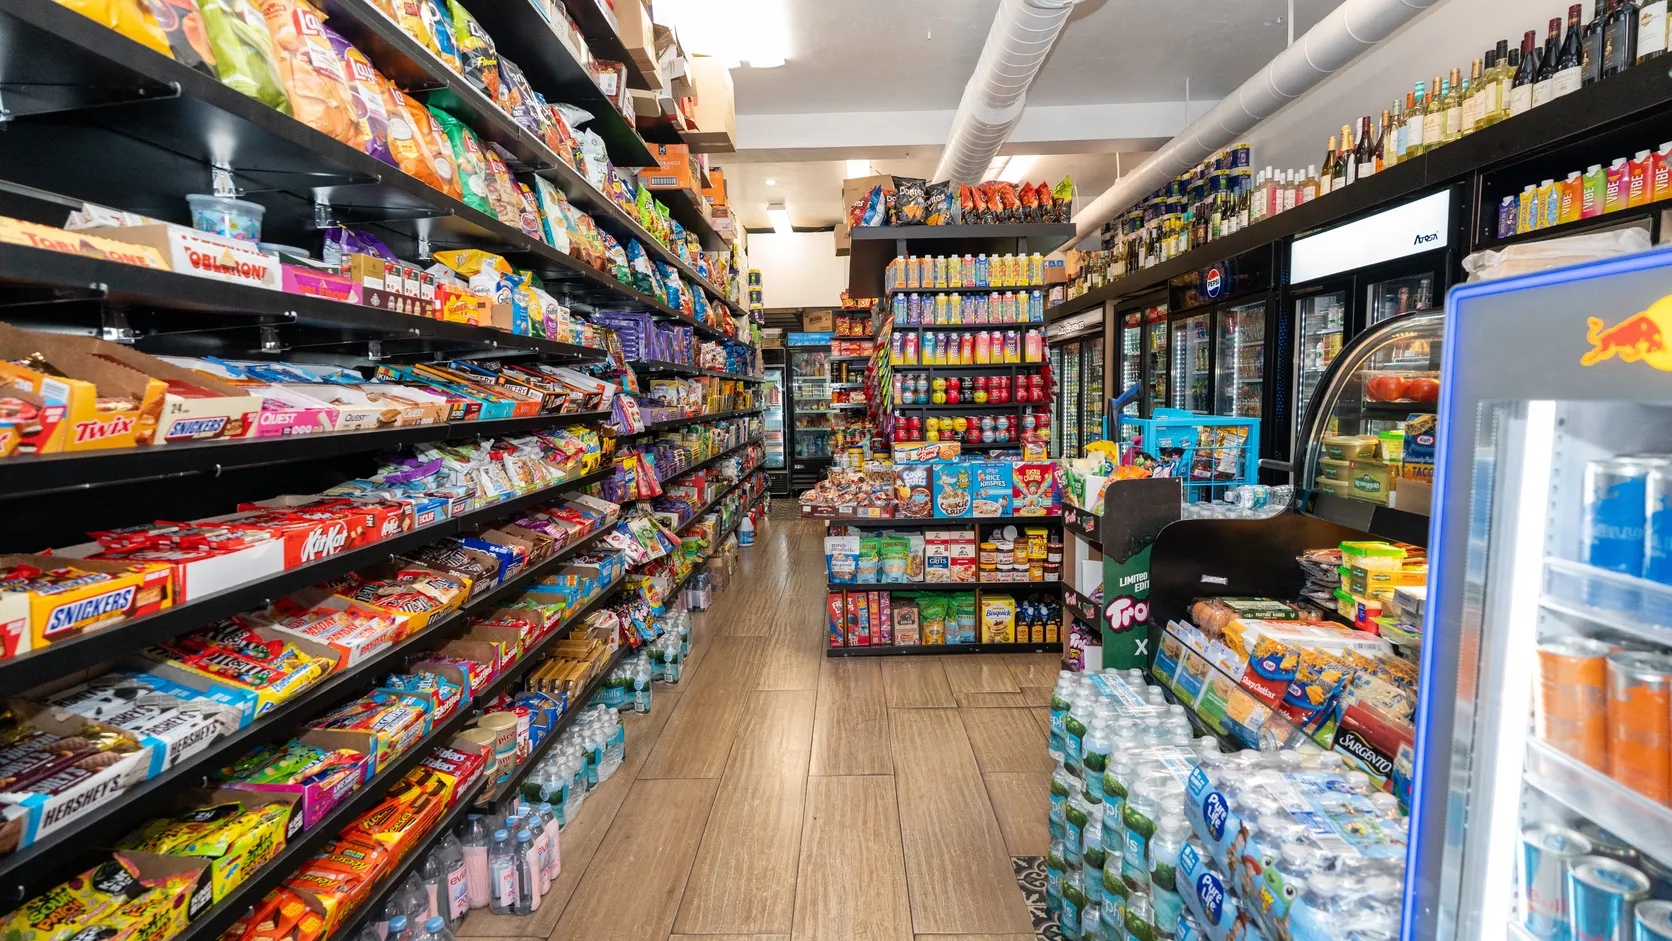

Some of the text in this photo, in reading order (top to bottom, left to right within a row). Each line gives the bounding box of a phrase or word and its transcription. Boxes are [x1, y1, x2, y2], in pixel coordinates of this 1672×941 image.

[899, 187, 925, 198] Doritos
[1207, 280, 1220, 288] PEPSI
[171, 403, 182, 414] 24
[260, 412, 297, 425] QUEST
[75, 416, 137, 444] Twix
[170, 418, 224, 436] SNICKERS
[980, 480, 1006, 488] KRISPIES
[50, 589, 132, 631] SNICKERS
[985, 609, 1012, 617] Bisquick
[1105, 597, 1149, 630] Tro
[1134, 638, 1149, 656] X
[1242, 676, 1256, 690] Sharp
[170, 720, 220, 757] HERSHEY'S
[1338, 734, 1393, 774] SARGENTO
[42, 773, 122, 829] HERSHEY'S
[1208, 793, 1228, 818] Pure
[1207, 806, 1221, 829] Life
[1202, 874, 1223, 901] Pure
[28, 890, 75, 924] SOUR
[1201, 888, 1217, 913] Life
[36, 899, 84, 932] PATCH
